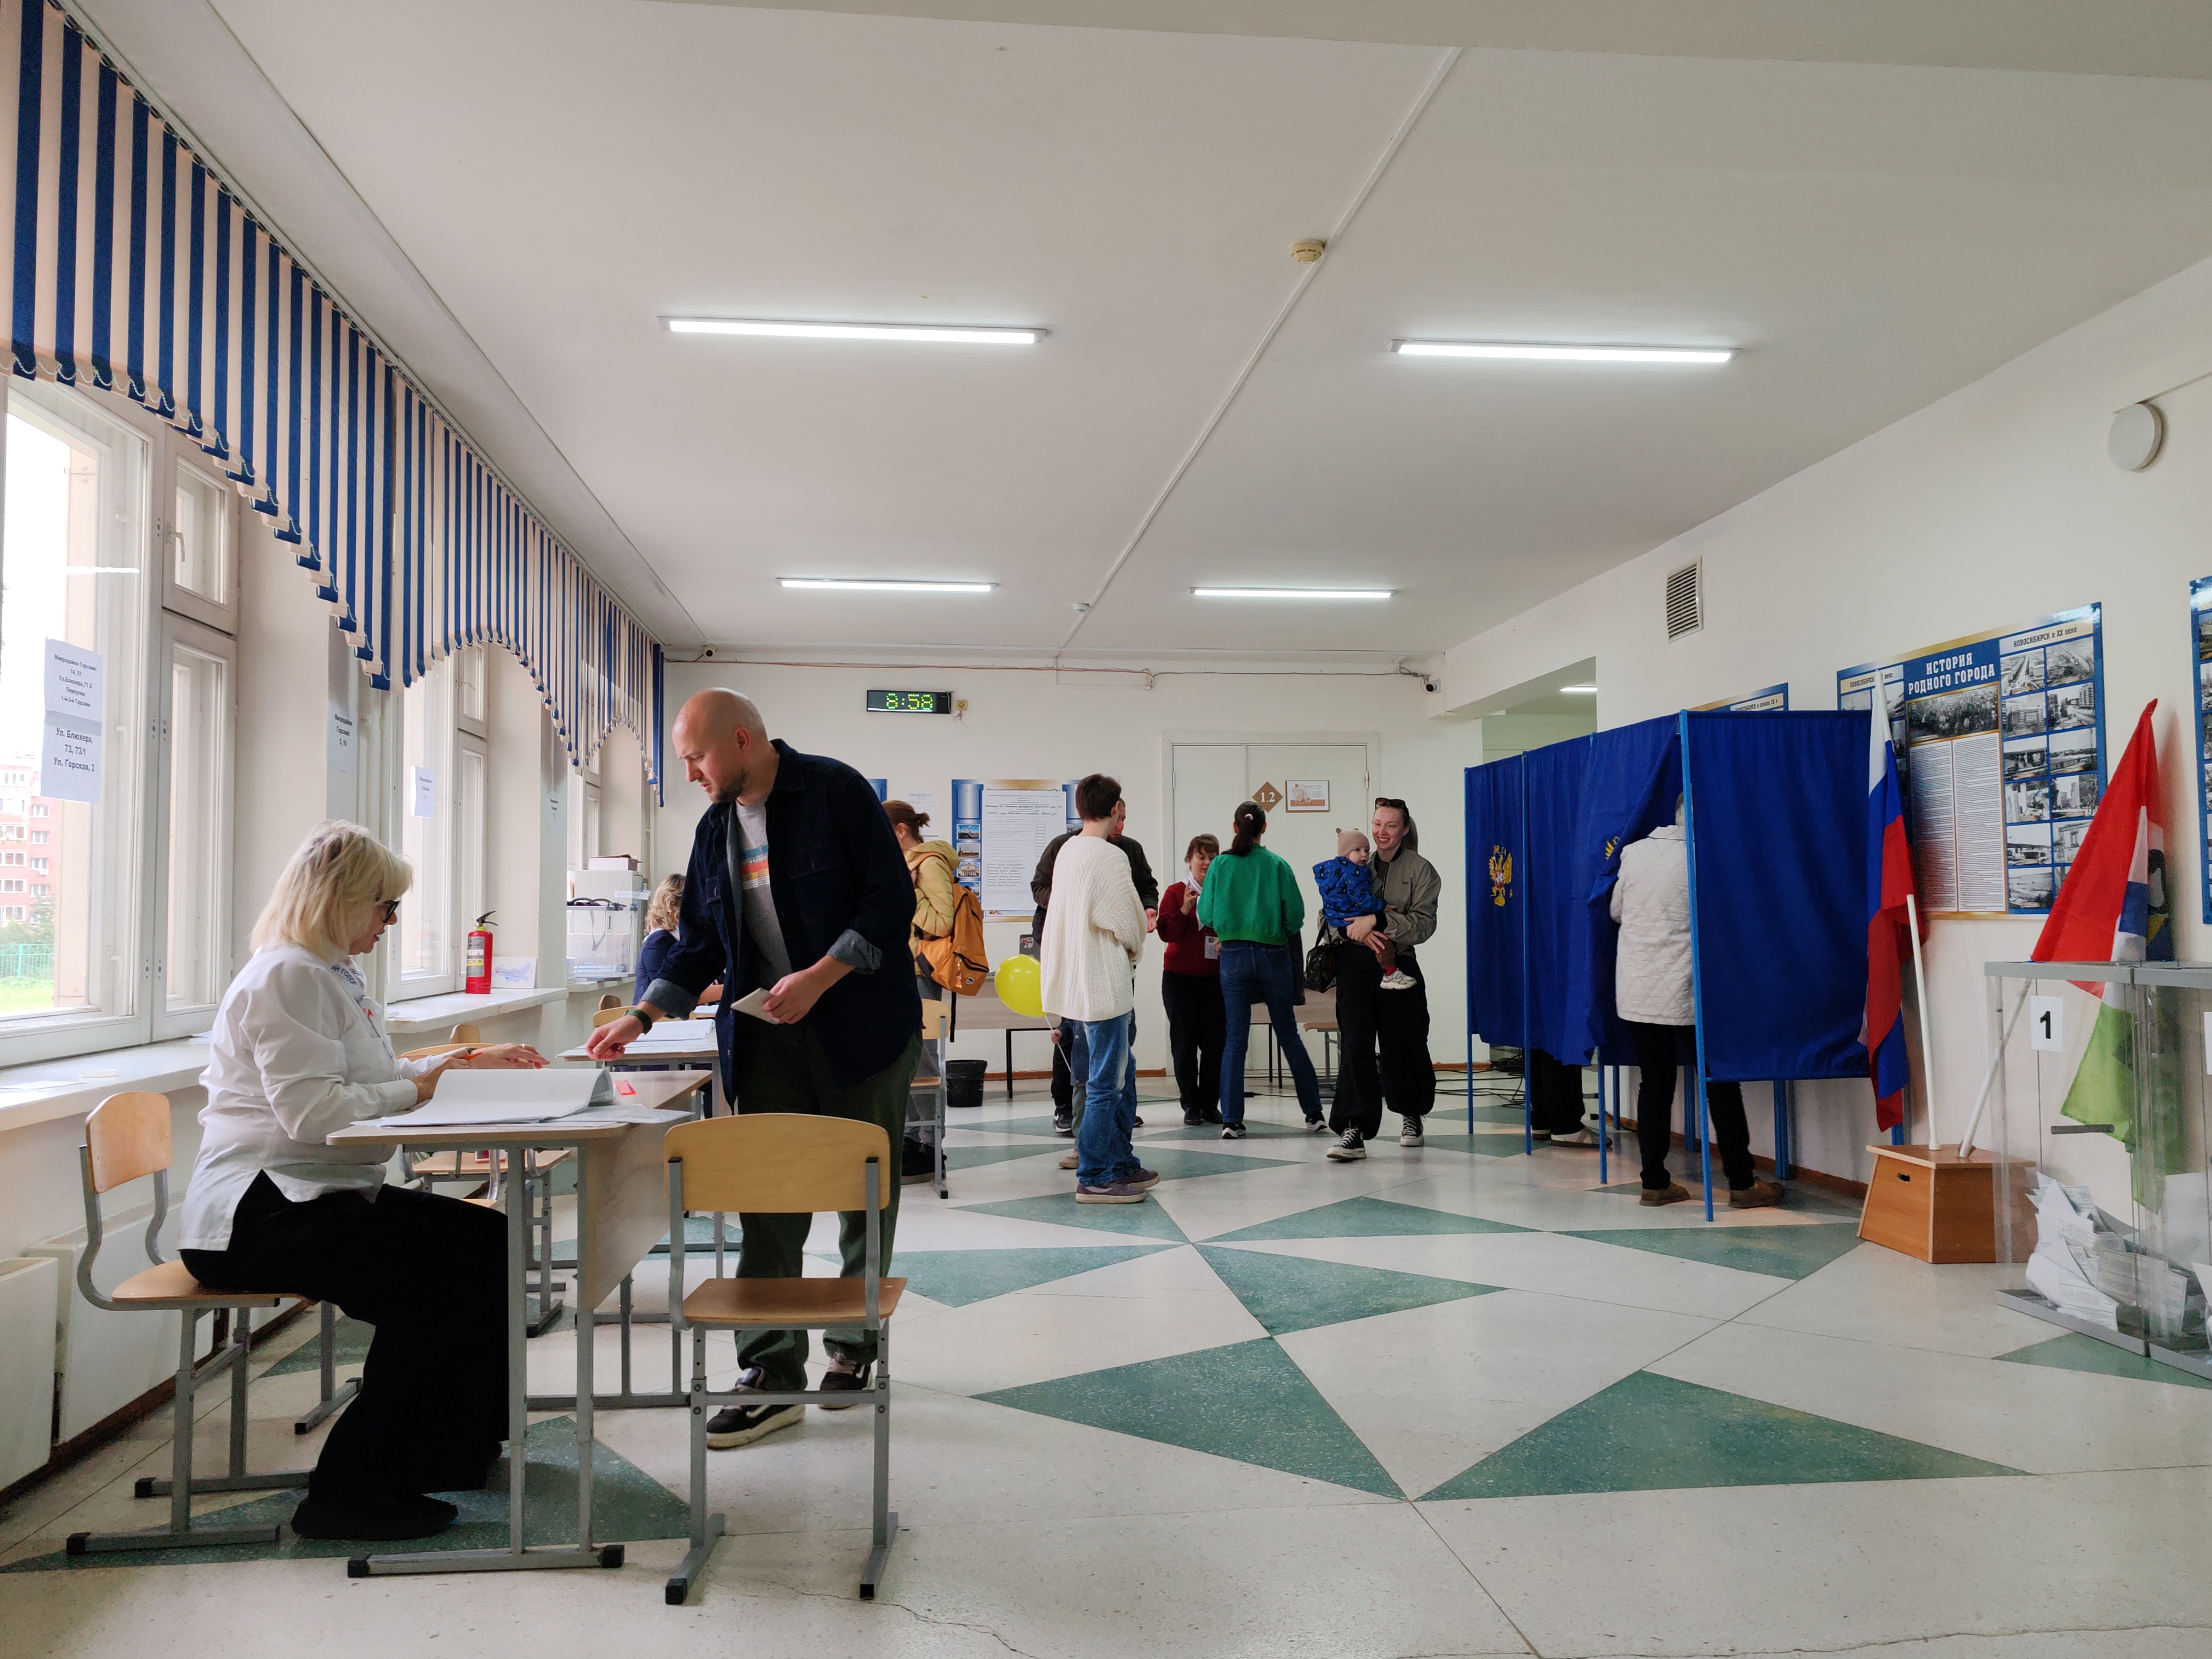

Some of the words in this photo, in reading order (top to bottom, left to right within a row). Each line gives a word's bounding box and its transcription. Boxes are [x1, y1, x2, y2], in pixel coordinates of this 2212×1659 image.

[2013, 632, 2050, 647] НОВОСИБИРСК
[1926, 652, 1973, 675] ИСТОРИЯ
[1908, 673, 1951, 695] РОДНОГО
[1955, 663, 1995, 685] ГОРОДА
[886, 693, 933, 710] 8:58
[56, 727, 65, 737] Ул.
[66, 730, 93, 745] Блюхера,
[65, 744, 73, 755] 73,
[54, 757, 63, 766] Ул.
[65, 759, 90, 772] Горская,
[91, 764, 95, 772] 2
[1260, 791, 1275, 802] 1.2
[2039, 1010, 2051, 1039] 1
